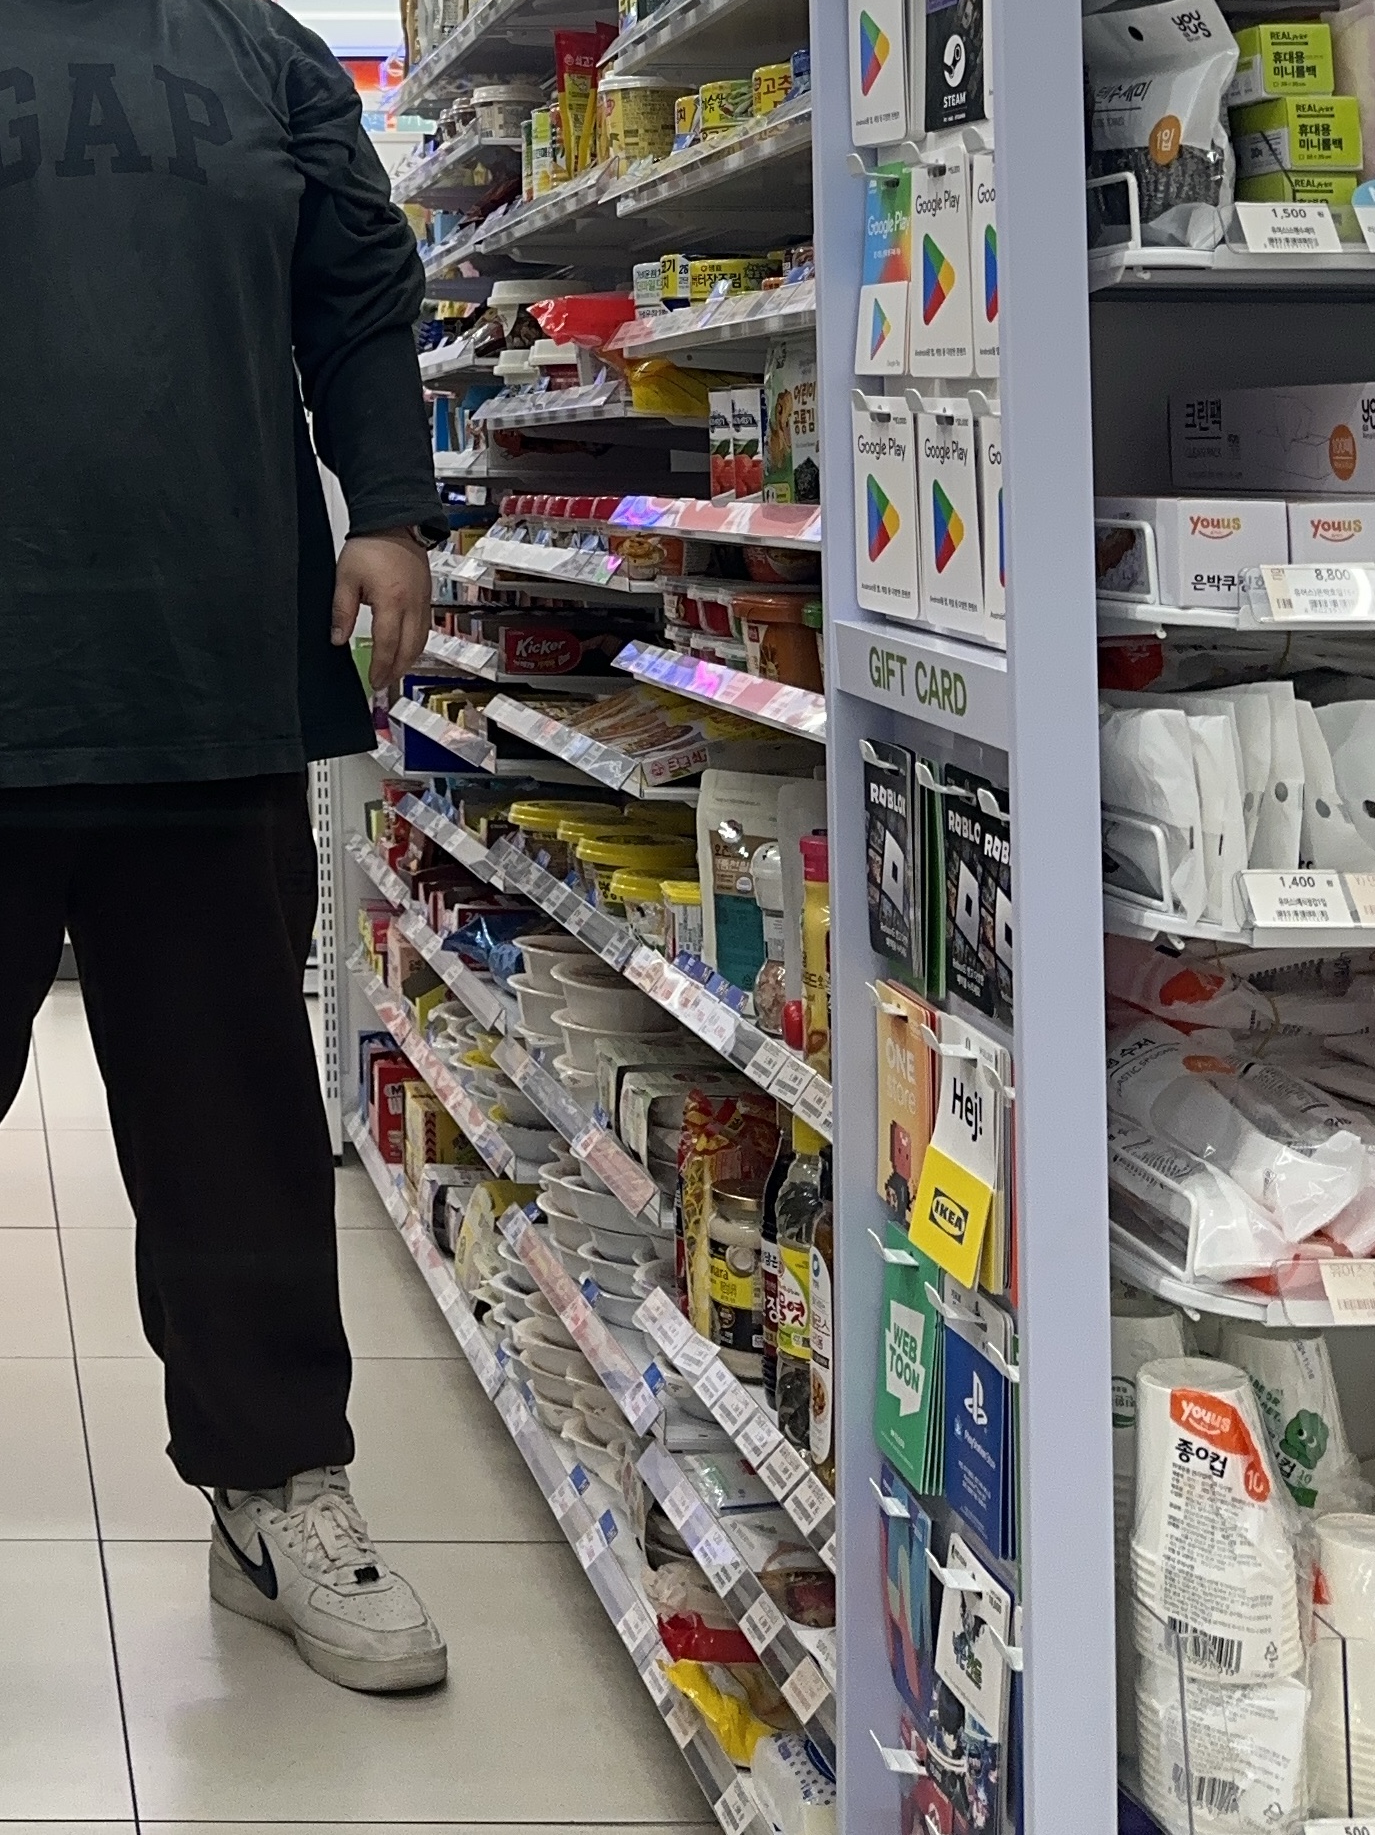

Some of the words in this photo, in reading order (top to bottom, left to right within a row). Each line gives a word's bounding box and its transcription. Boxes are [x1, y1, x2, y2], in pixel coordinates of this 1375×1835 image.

[1270, 31, 1290, 41] REAL
[1273, 51, 1304, 65] 휴대용
[944, 92, 966, 109] STEAM
[1296, 104, 1316, 113] REAL
[1299, 123, 1331, 137] 휴대용
[1294, 179, 1315, 188] REAL
[915, 195, 942, 217] Google
[944, 191, 960, 214] Play
[1271, 208, 1307, 220] 1,500
[868, 215, 893, 239] Google
[895, 211, 911, 236] Play
[793, 380, 816, 405] 어린이
[858, 434, 886, 460] Google
[889, 438, 906, 461] Play
[925, 438, 950, 464] Google
[952, 441, 968, 466] Play
[1189, 516, 1241, 535] youus
[1311, 519, 1362, 539] youus
[1315, 568, 1351, 581] 8,800
[516, 636, 566, 657] Kicker
[869, 645, 907, 695] GIFT
[915, 664, 967, 717] CARD
[1280, 876, 1315, 889] 1,400
[886, 1037, 916, 1084] ONE
[952, 1077, 983, 1142] Hej!
[934, 1201, 964, 1233] IKEA
[893, 1322, 918, 1364] WEB
[889, 1344, 920, 1394] TOON
[1181, 1400, 1231, 1434] youus
